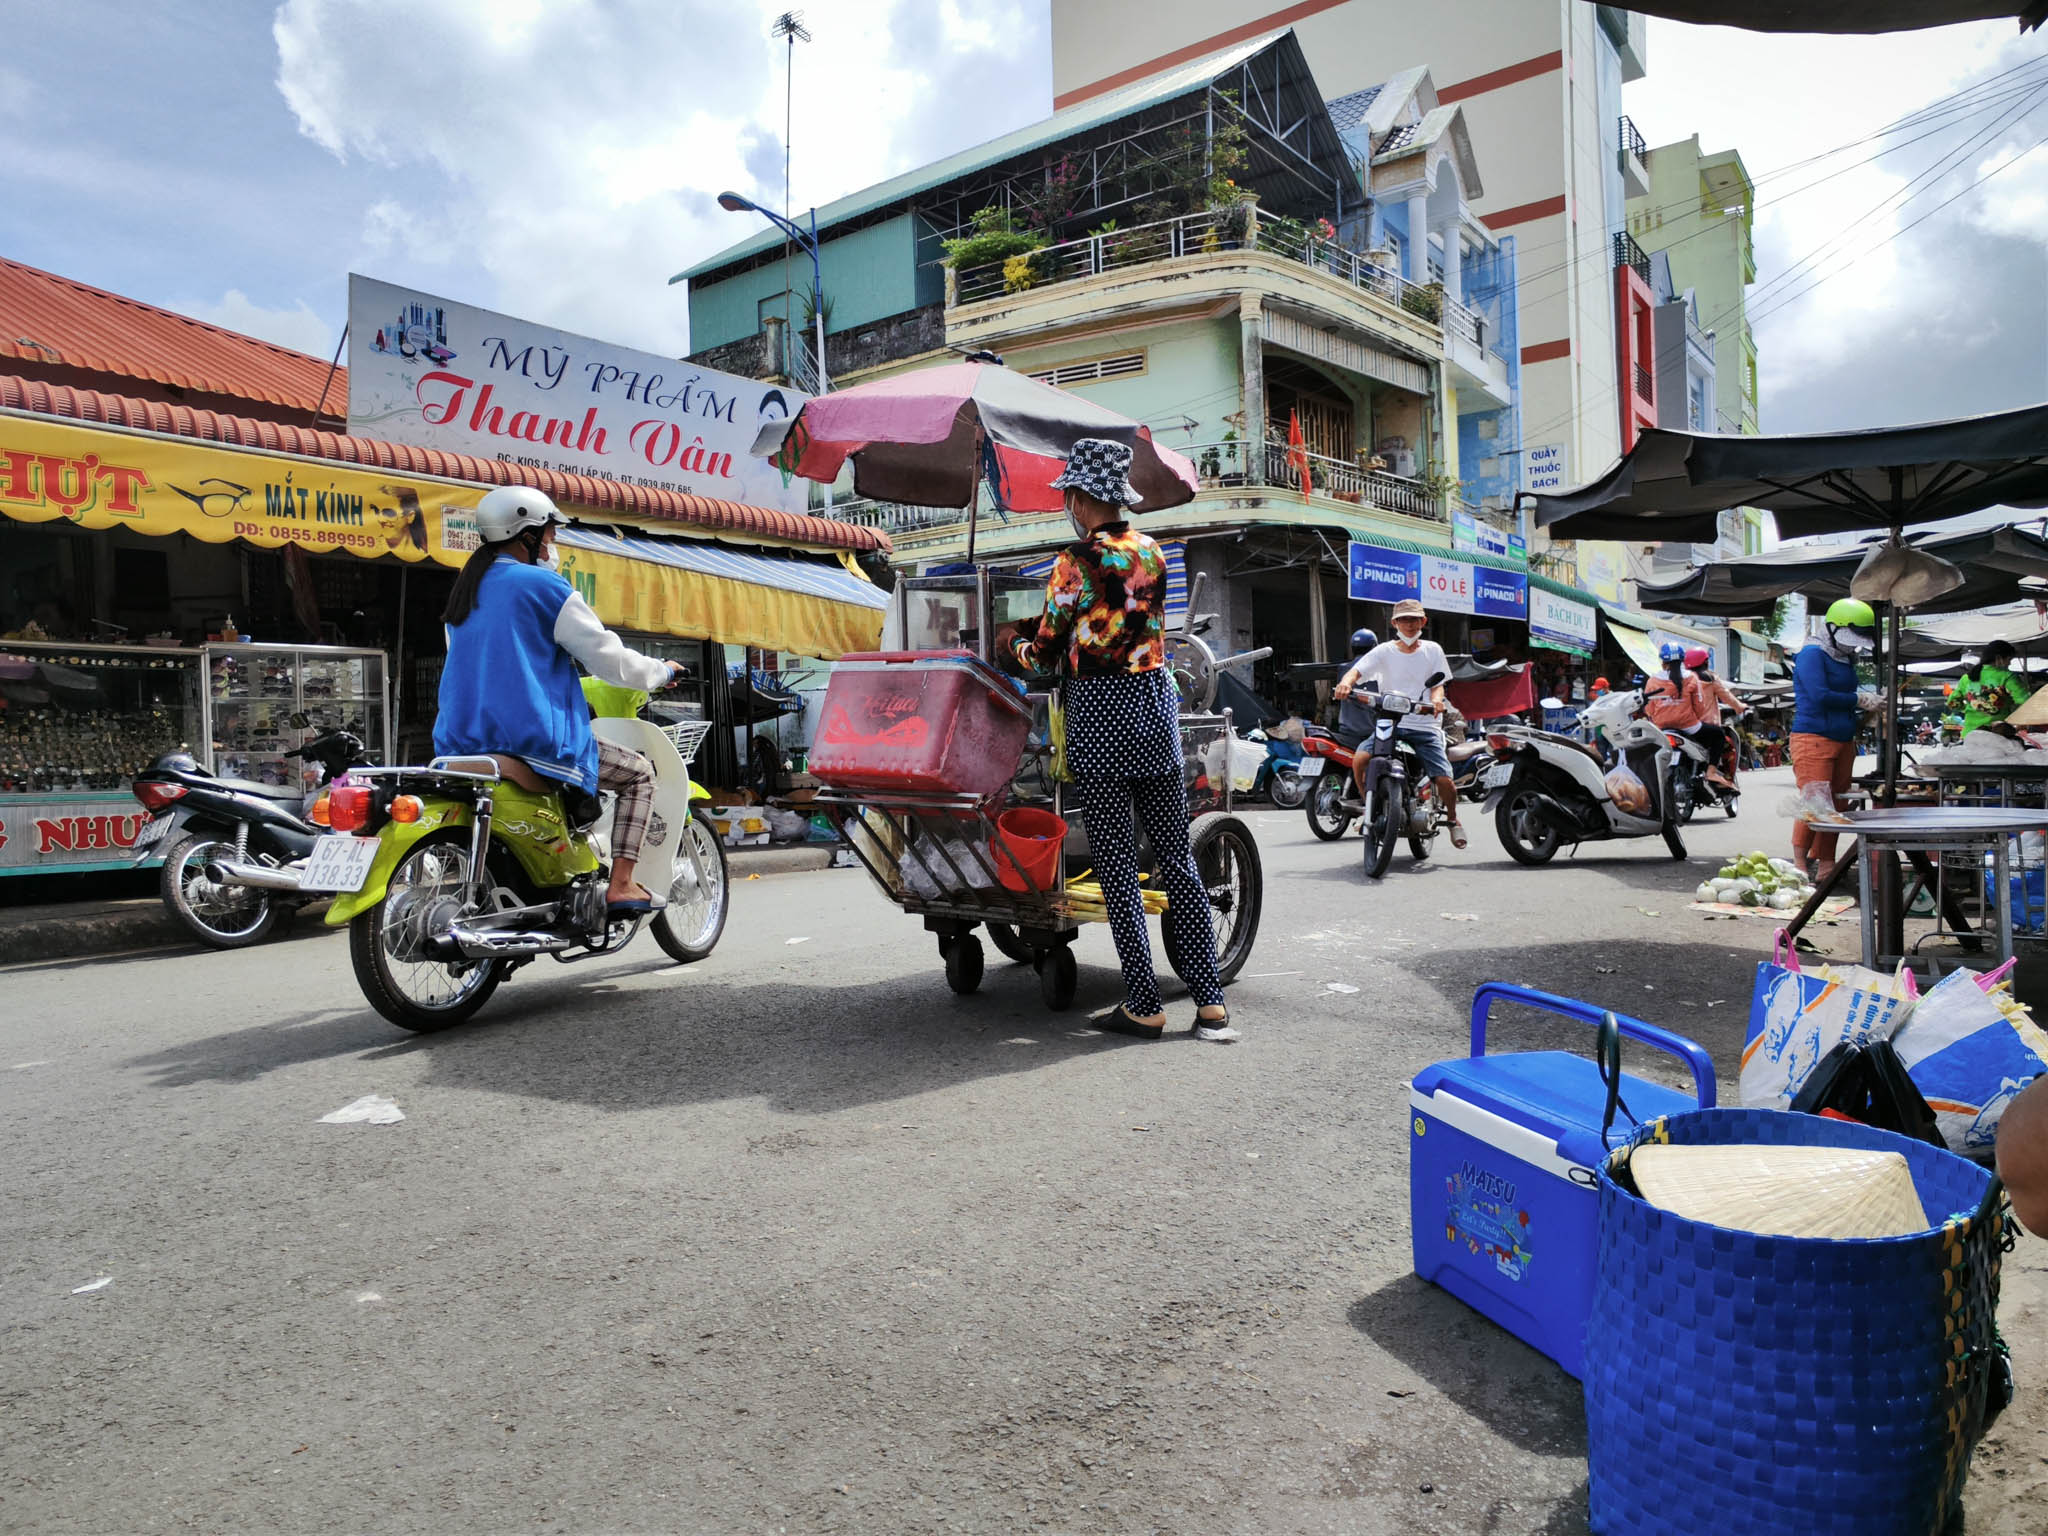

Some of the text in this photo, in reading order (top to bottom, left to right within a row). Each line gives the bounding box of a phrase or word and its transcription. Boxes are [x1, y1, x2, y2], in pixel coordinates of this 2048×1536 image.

[481, 337, 737, 424] MỸ PHẨM
[416, 371, 736, 479] Thanh Vân
[518, 455, 540, 469] KIOS
[265, 471, 364, 527] MẮT KÍNH
[233, 521, 376, 548] DĐ: 0855.889959
[1363, 568, 1406, 585] PINACO
[1483, 588, 1516, 603] PINACO
[321, 839, 366, 863] 67-AL
[309, 863, 364, 887] 138.33
[1459, 1159, 1517, 1206] MATSU
